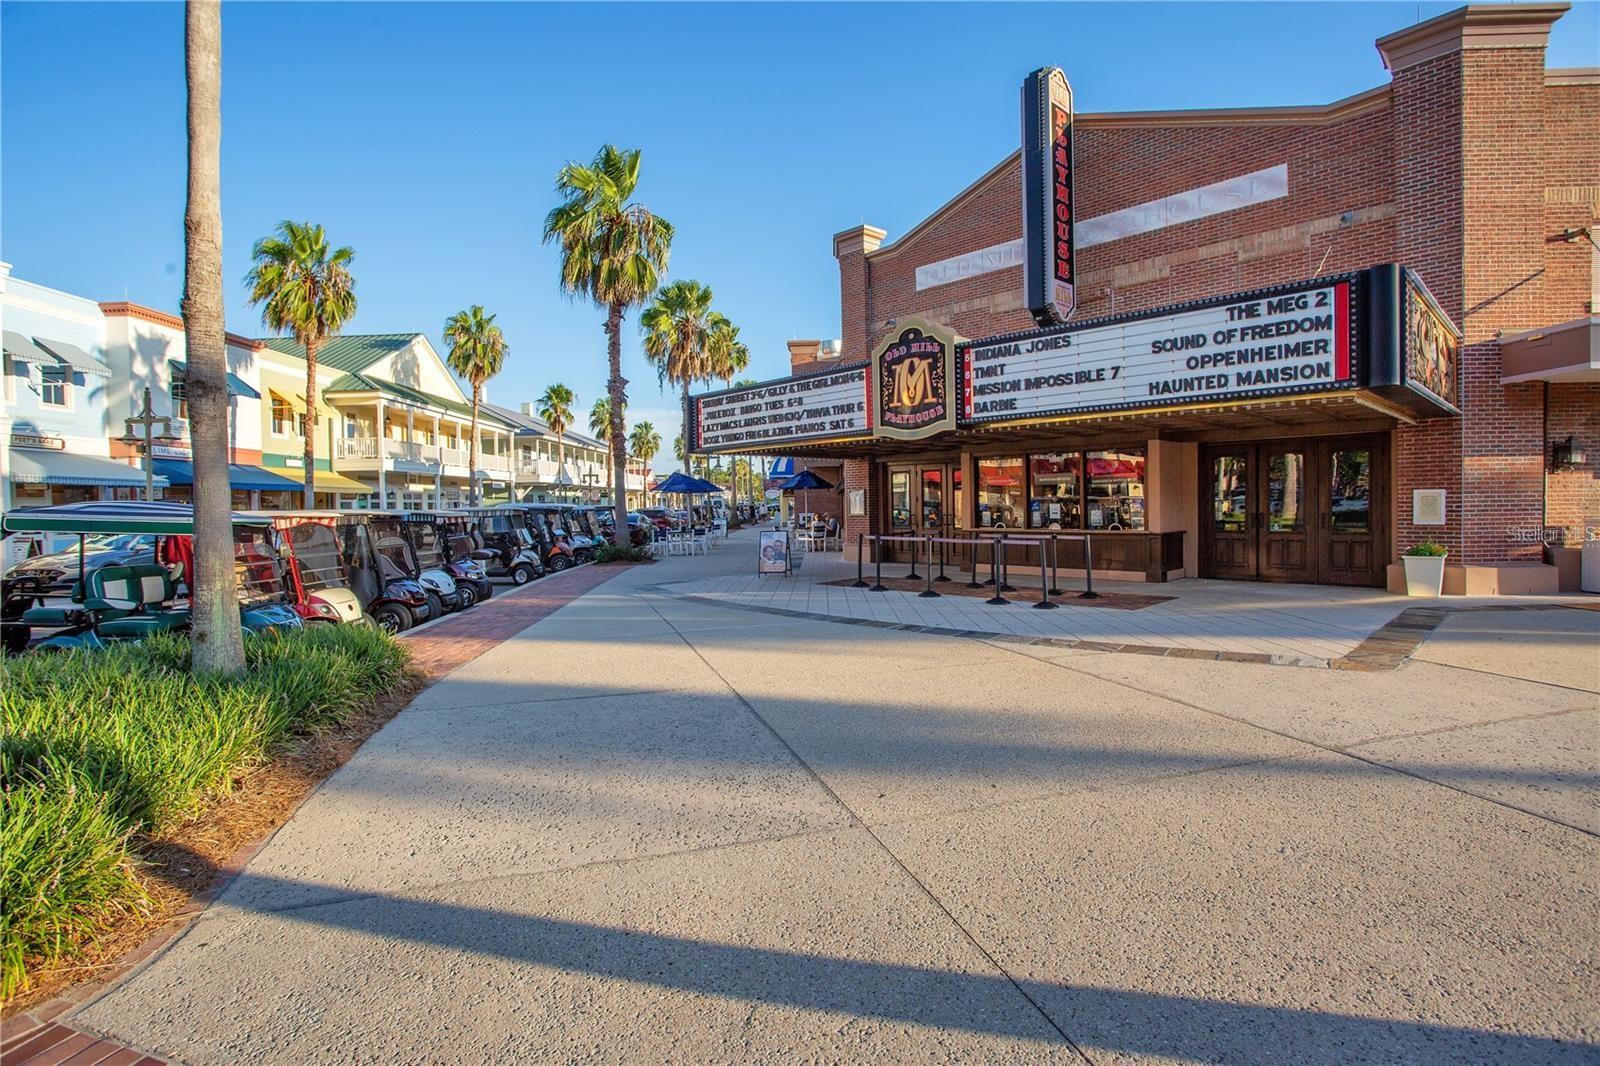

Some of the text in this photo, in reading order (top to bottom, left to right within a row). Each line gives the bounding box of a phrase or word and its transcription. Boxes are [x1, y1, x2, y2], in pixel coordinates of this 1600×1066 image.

[1055, 107, 1071, 279] PLAYHOUSE
[1226, 291, 1328, 321] THE MEG 2
[1152, 314, 1333, 354] SOUND OF FREEDOM
[885, 342, 941, 360] OLD MILL
[974, 335, 1072, 362] INDIANA JONES
[1186, 338, 1329, 370] OPPENHEIMER
[973, 366, 1121, 397] MISSION IMPOSSIBLE 7
[974, 364, 1006, 379] TMNT
[1149, 362, 1330, 396] HAUNTED MANSION
[764, 401, 784, 411] TUES
[831, 404, 855, 415] THUR
[857, 402, 864, 412] 6
[884, 405, 944, 424] PLAYHOUSE
[974, 398, 1017, 414] BARBIE
[795, 422, 826, 434] PIANOS
[829, 420, 846, 431] SAT
[847, 418, 854, 428] 6
